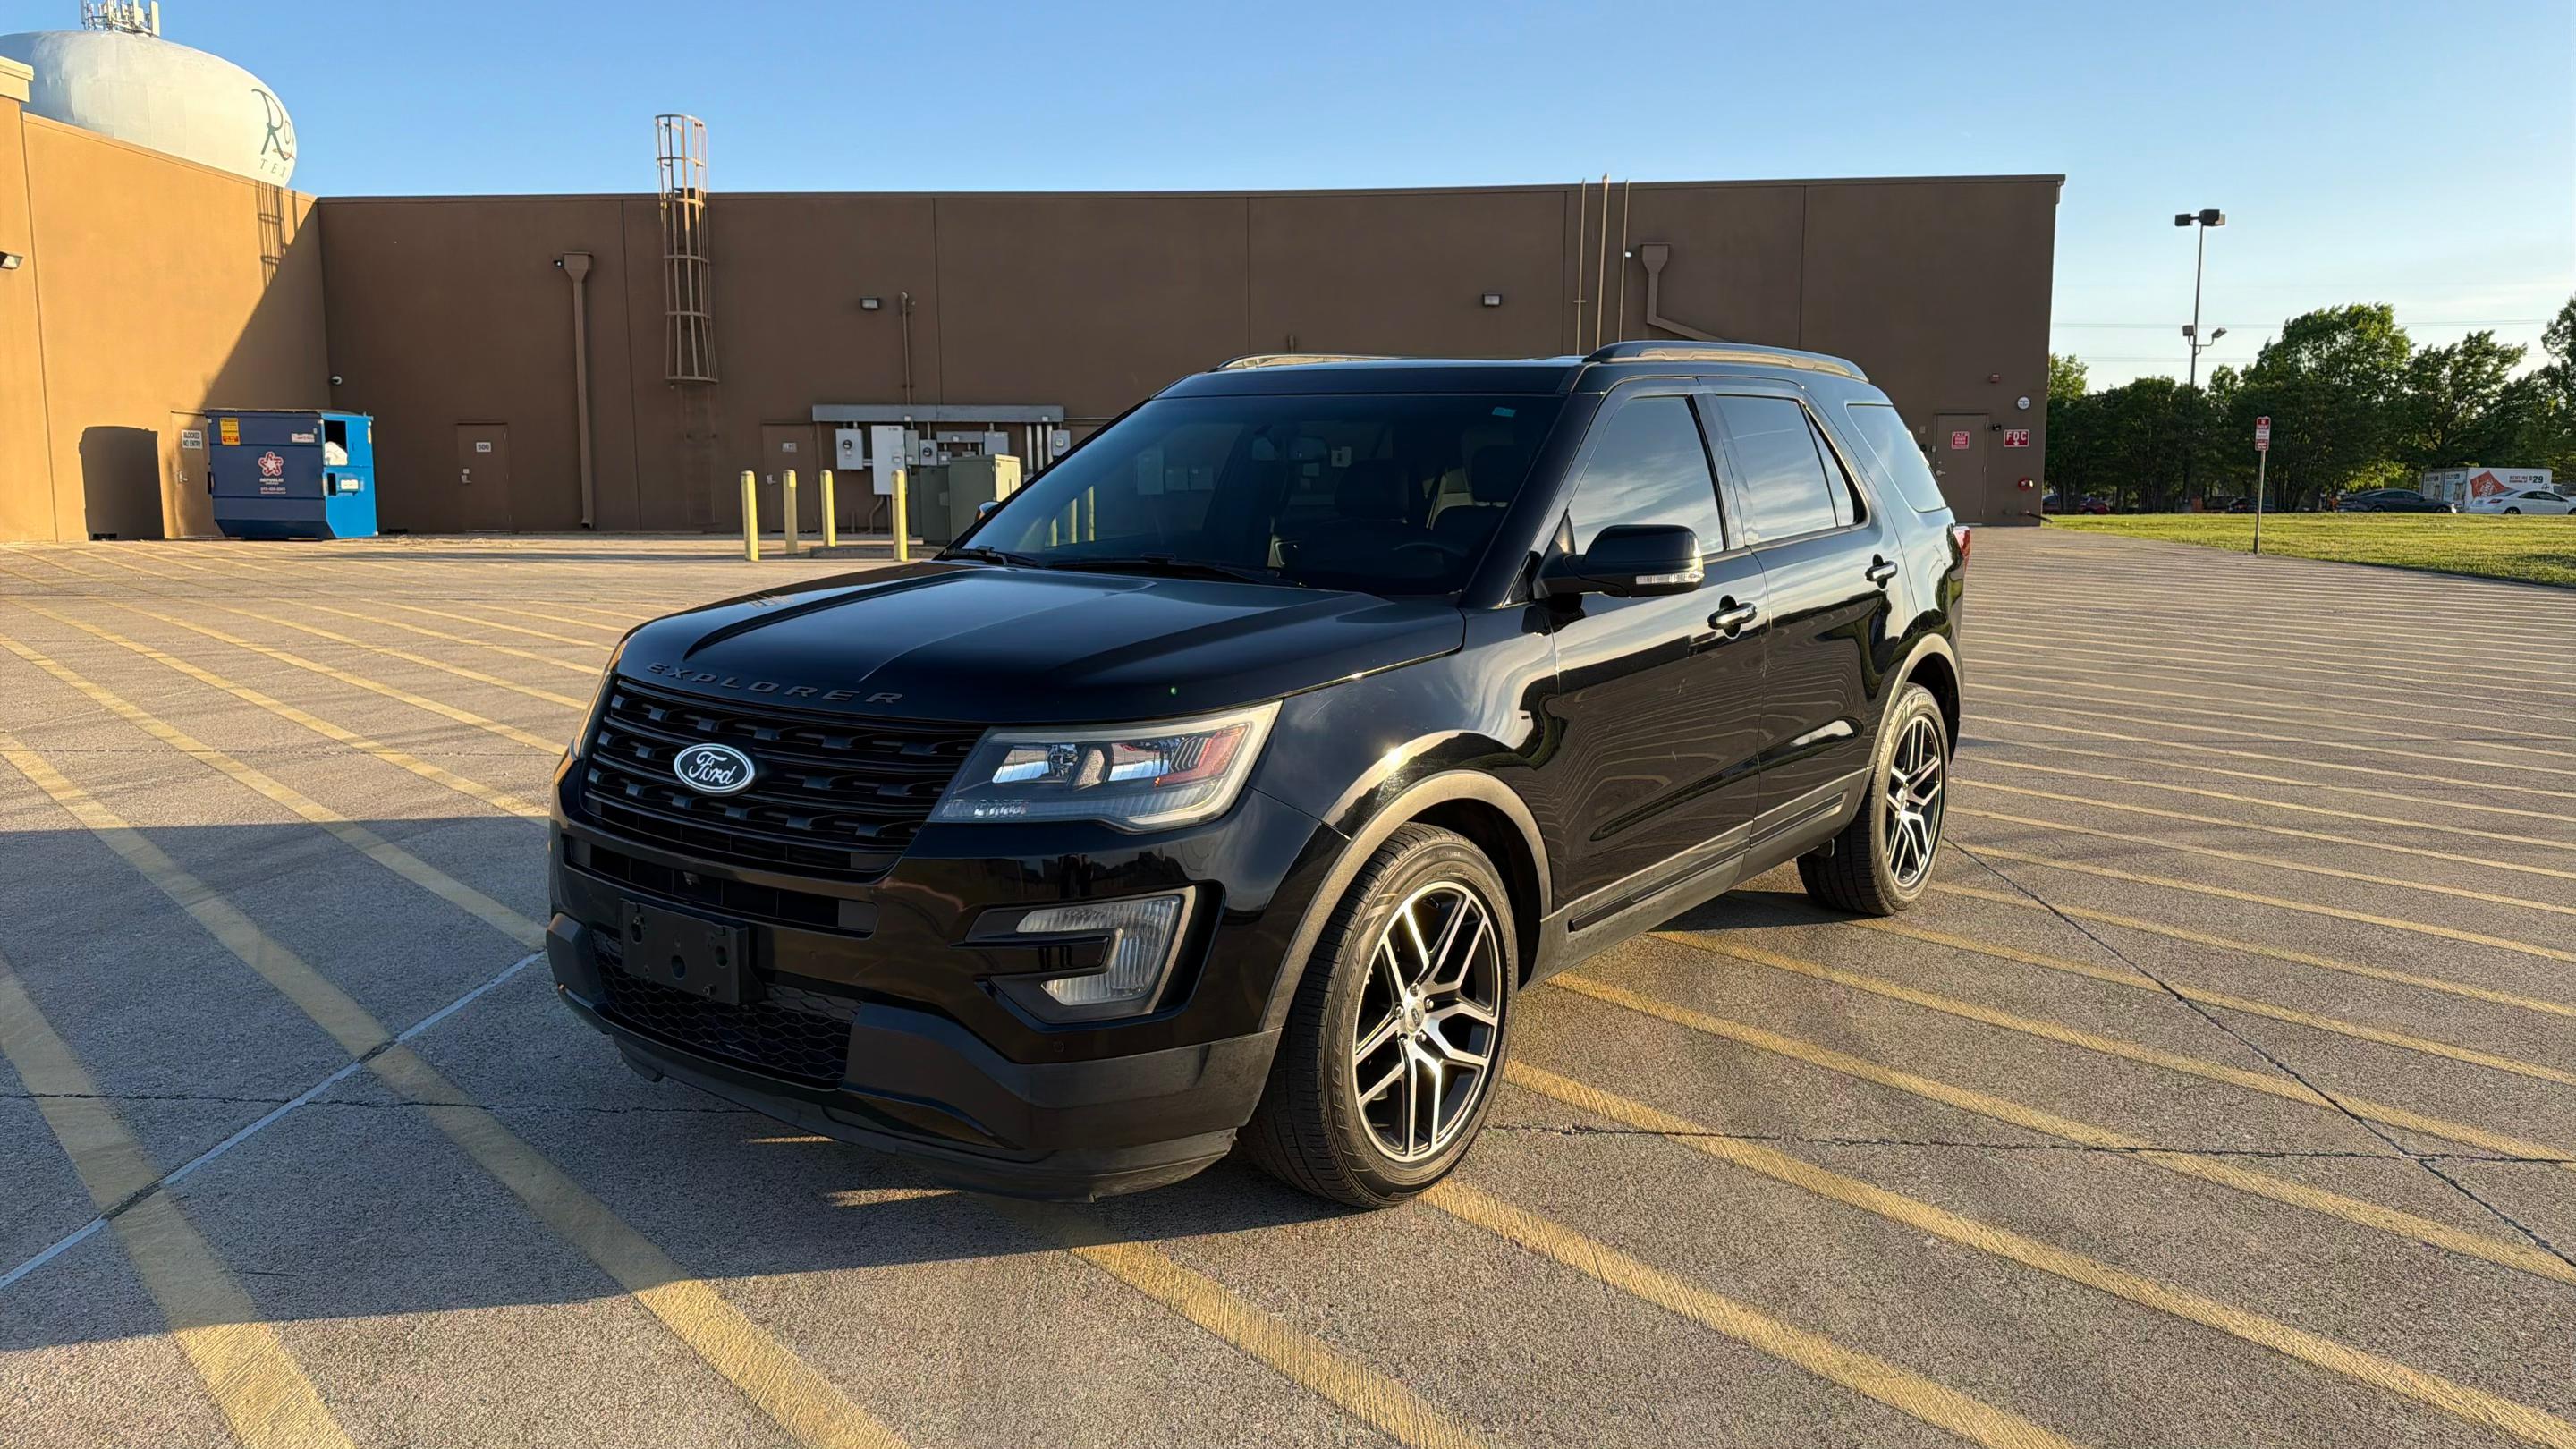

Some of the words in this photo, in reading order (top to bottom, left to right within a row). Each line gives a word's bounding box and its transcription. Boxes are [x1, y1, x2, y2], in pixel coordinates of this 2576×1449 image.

[183, 431, 200, 439] BLOCKED
[2006, 431, 2027, 441] FDC
[2529, 475, 2544, 484] $29
[646, 662, 903, 704] EXPLORER
[688, 750, 737, 784] Ford
